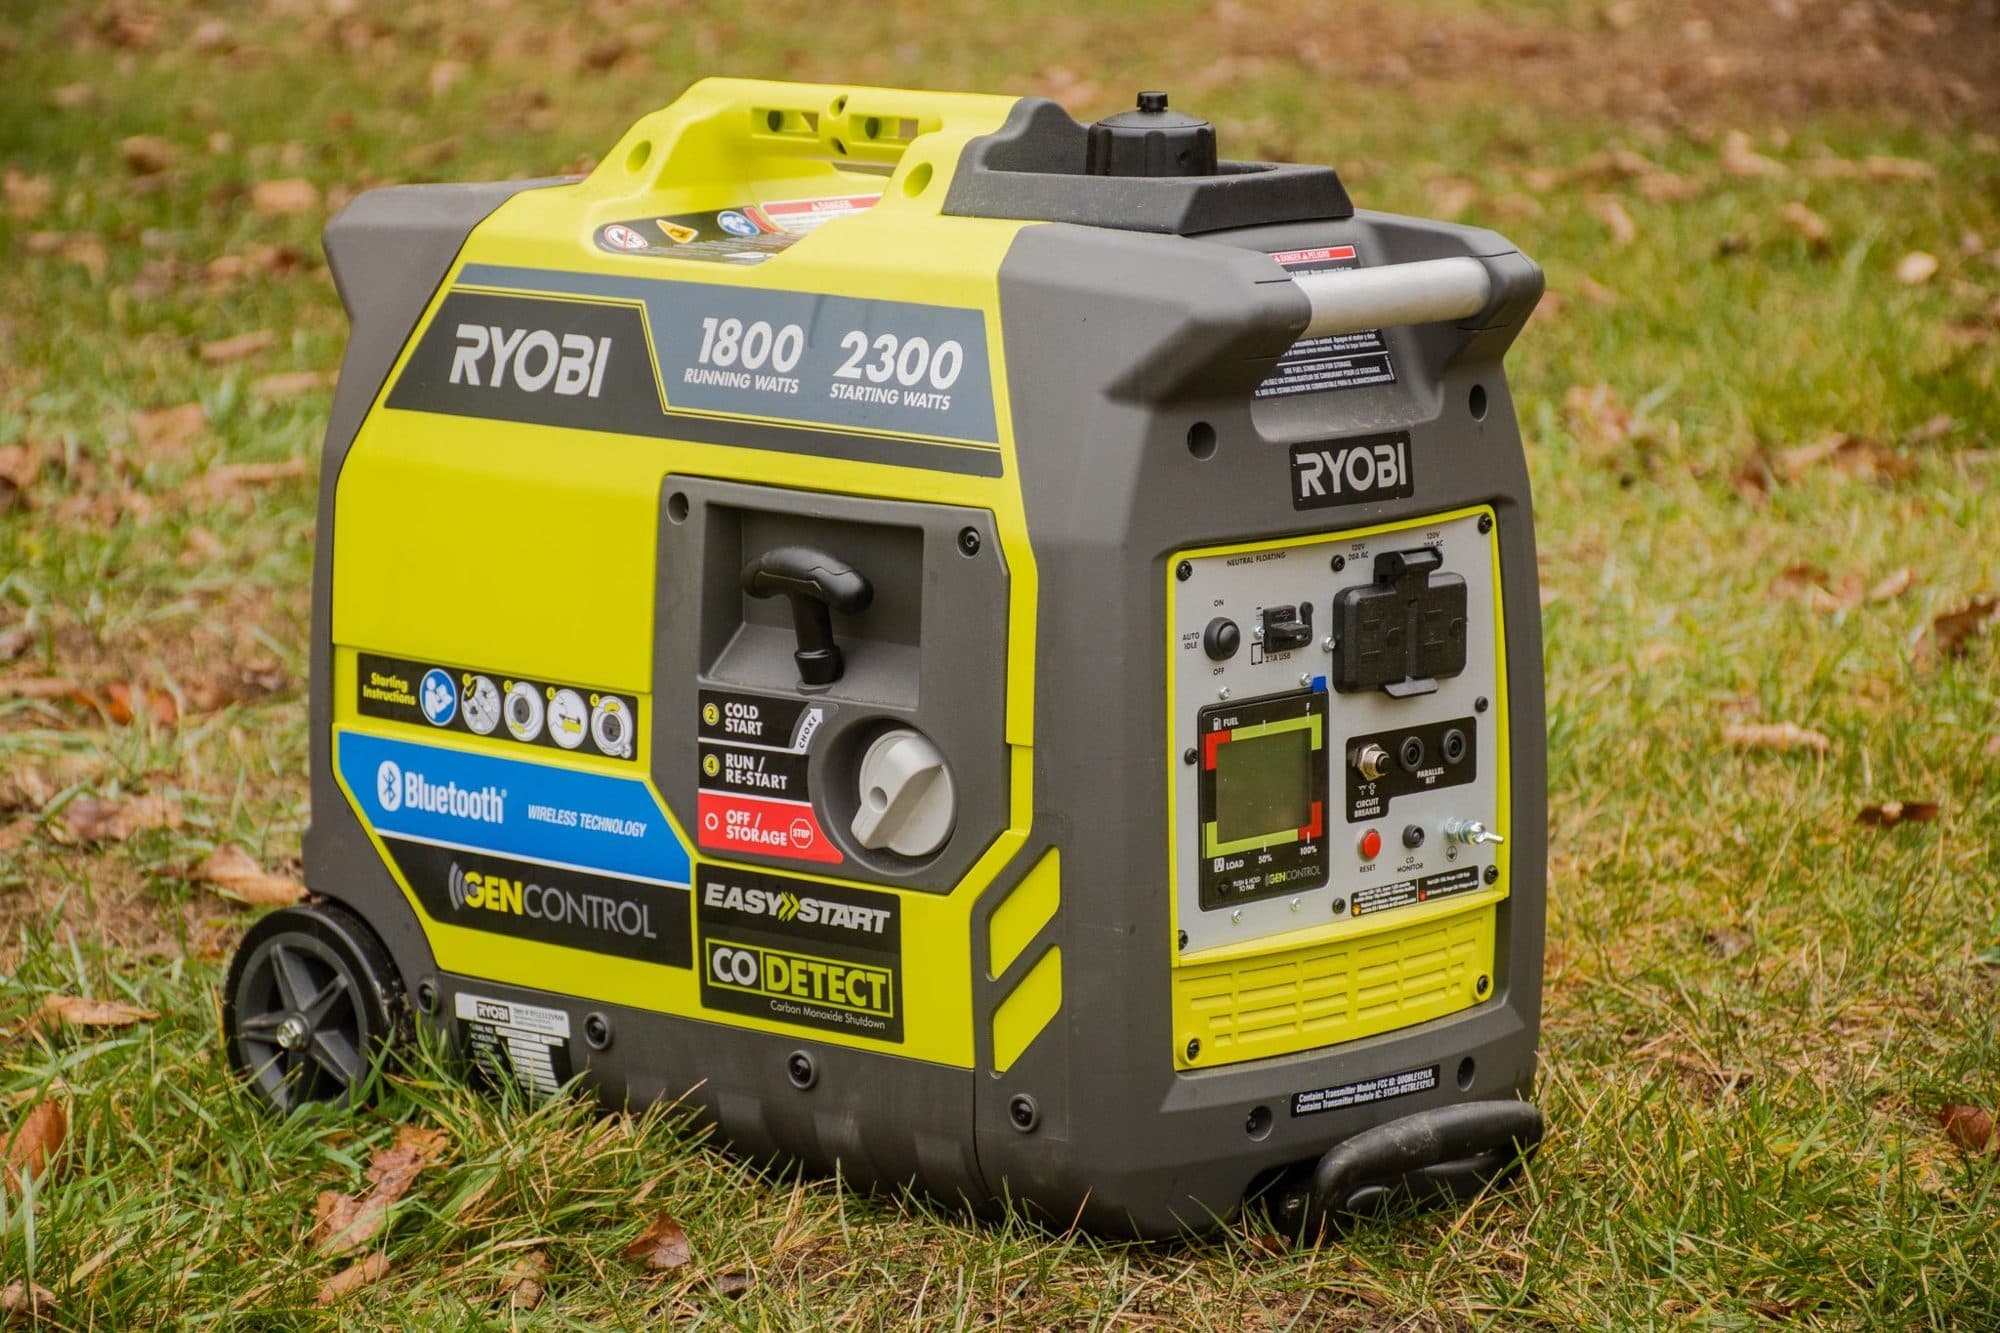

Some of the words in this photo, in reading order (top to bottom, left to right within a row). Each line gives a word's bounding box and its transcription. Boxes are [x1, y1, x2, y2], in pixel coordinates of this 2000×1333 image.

[449, 324, 612, 398] RYOBI
[698, 317, 804, 373] 1800
[833, 331, 963, 390] 2300
[684, 369, 753, 391] RUNNING
[754, 375, 799, 395] WATTS
[830, 384, 899, 406] STARTING
[902, 391, 951, 411] WATTS
[1296, 442, 1407, 497] RYOBI
[1226, 557, 1254, 567] NEUTRAL
[1256, 552, 1286, 563] FLOATING
[1360, 551, 1369, 559] AC
[1213, 599, 1225, 607] ON
[1182, 632, 1200, 641] AUTO
[1184, 642, 1198, 650] IDLE
[1279, 652, 1291, 661] USB
[1213, 667, 1225, 676] OFF
[371, 672, 408, 693] Starting
[363, 684, 416, 705] Instructions
[725, 702, 758, 720] COLD
[1305, 702, 1311, 712] F
[725, 718, 763, 736] START
[1223, 717, 1239, 727] FUEL
[799, 715, 818, 749] CHOKE
[725, 752, 755, 770] RUN
[726, 769, 788, 791] RE-START
[1416, 768, 1444, 778] PARALLEL
[1425, 776, 1436, 784] KIT
[1356, 797, 1379, 808] CIRCUIT
[726, 809, 750, 825] OFF
[1354, 806, 1380, 818] BREAKER
[528, 803, 577, 827] WIRELESS
[580, 812, 647, 838] TECHNOLOGY
[726, 824, 788, 846] STORAGE
[792, 828, 810, 839] STOP
[1300, 845, 1317, 856] 100%
[1226, 860, 1244, 870] LOAD
[1258, 853, 1273, 864] 50%
[1405, 856, 1415, 864] CO
[1359, 863, 1376, 873] RESET
[1397, 862, 1424, 873] MONITOR
[460, 870, 656, 939] GENCONTROL
[704, 882, 782, 917] EASY
[797, 897, 890, 934] START
[712, 946, 758, 986] CO
[765, 954, 886, 1010] DETECT
[478, 1003, 509, 1021] RYOBI
[770, 999, 801, 1016] Carbon
[803, 1006, 843, 1024] Monoxide
[845, 1012, 886, 1030] Shutdown
